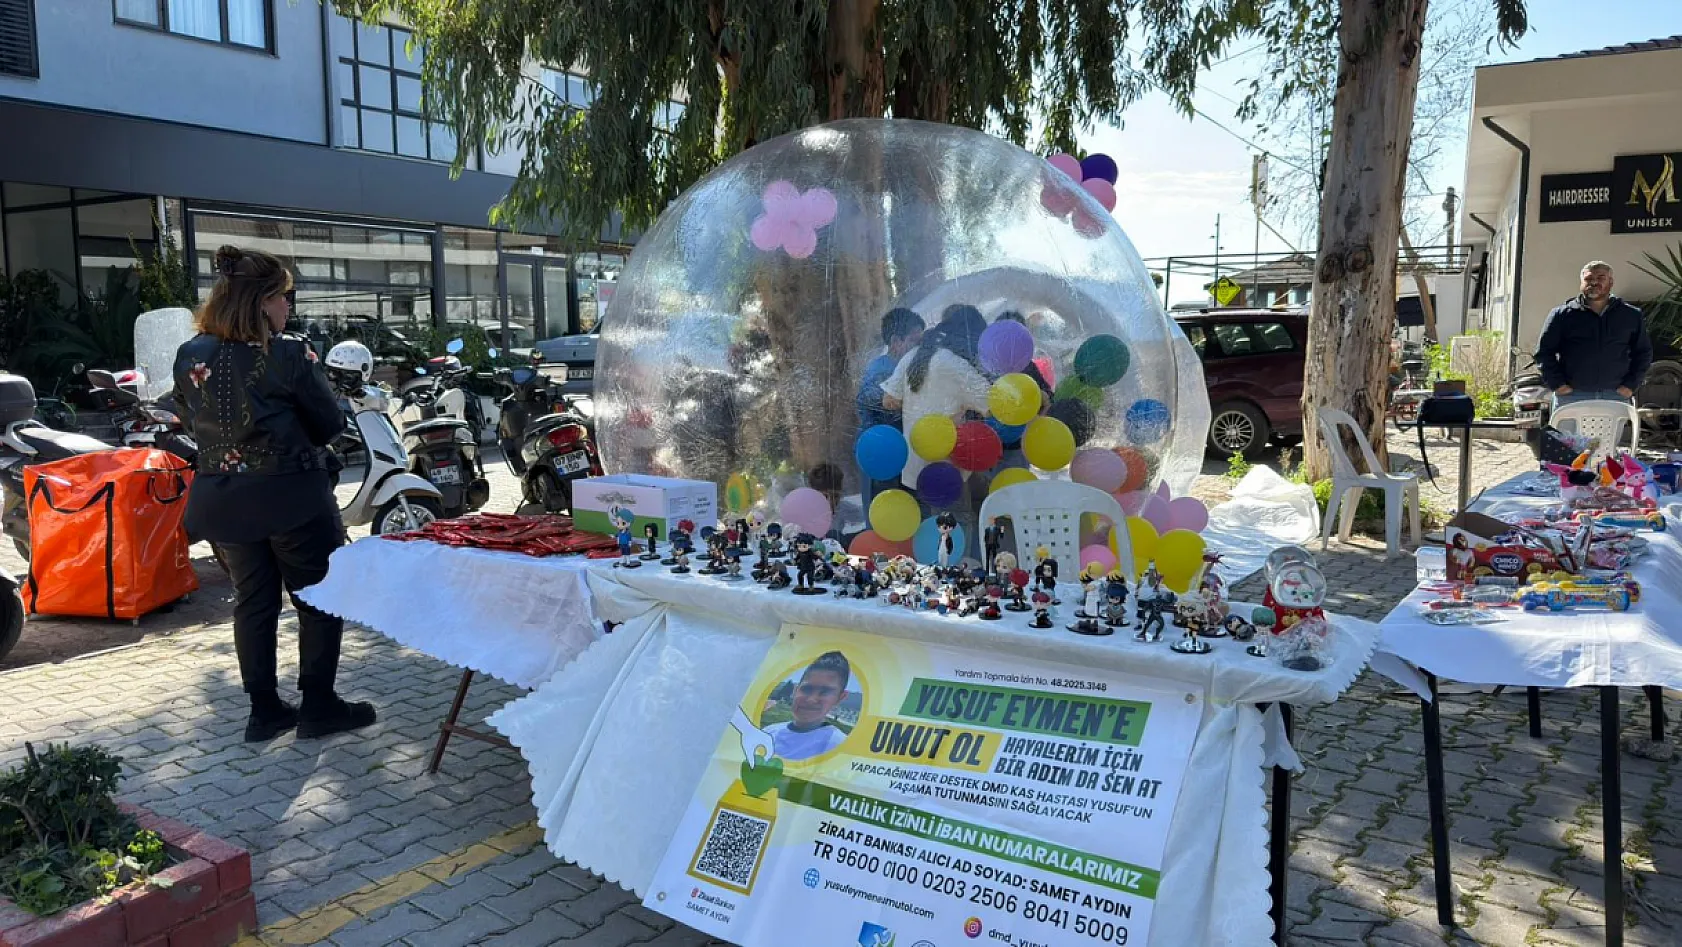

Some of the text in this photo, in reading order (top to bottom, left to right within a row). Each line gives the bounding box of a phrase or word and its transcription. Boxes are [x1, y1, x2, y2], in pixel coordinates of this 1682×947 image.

[1549, 187, 1610, 206] HAIRDRESSER
[1627, 217, 1673, 228] UNISEX
[915, 684, 1004, 722] YUSUF
[955, 669, 983, 680] Yardım
[984, 671, 1019, 683] Topmala
[1036, 677, 1048, 686] No.
[1050, 678, 1107, 692] 48.2025.3148
[870, 720, 986, 766] UMUT OL
[1003, 736, 1144, 773] HAYALLERİM İÇİN
[850, 761, 919, 781] YAPACAĞINIZ
[919, 772, 938, 783] HER
[940, 775, 981, 790] DESTEK
[981, 780, 1009, 794] DMD
[1010, 785, 1035, 799] KAS
[1036, 790, 1088, 809] HASTASI
[994, 753, 1163, 799] BİR ADIM DA SEN AT
[889, 780, 1093, 824] YAŞAMA TUTUNMASINI SAĞLAYACAK
[829, 793, 1144, 890] VALİLİK İZİNLİ İBAN NUMARALARIMIZ
[818, 820, 1132, 920] ZİRAAT BANKASI ALICI AD SOYAD: SAMET AYDIN
[812, 840, 1129, 946] TR 9600 0100 0203 2506 8041 5009
